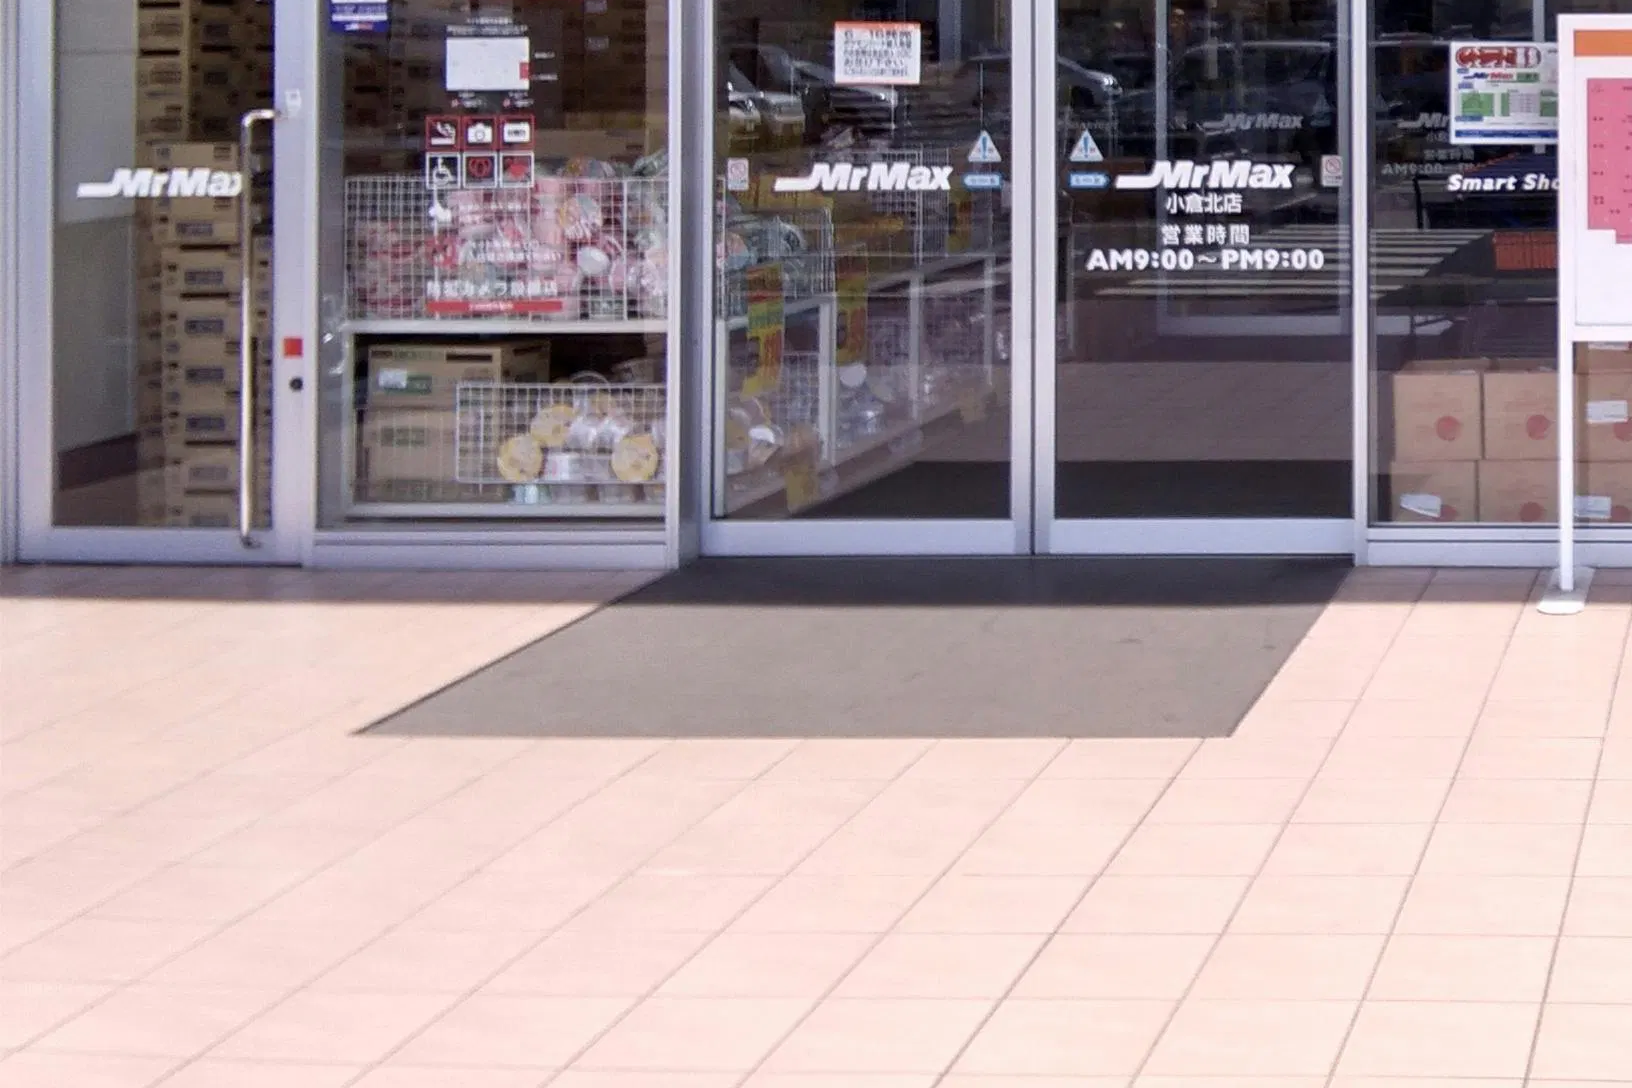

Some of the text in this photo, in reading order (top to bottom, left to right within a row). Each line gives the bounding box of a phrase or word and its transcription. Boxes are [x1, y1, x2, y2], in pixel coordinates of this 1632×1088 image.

[773, 162, 954, 191] MrMax
[1115, 160, 1296, 189] MrMax
[1447, 173, 1518, 191] Smart
[1166, 192, 1243, 214] 小倉北店
[1160, 224, 1250, 246] 営業時間
